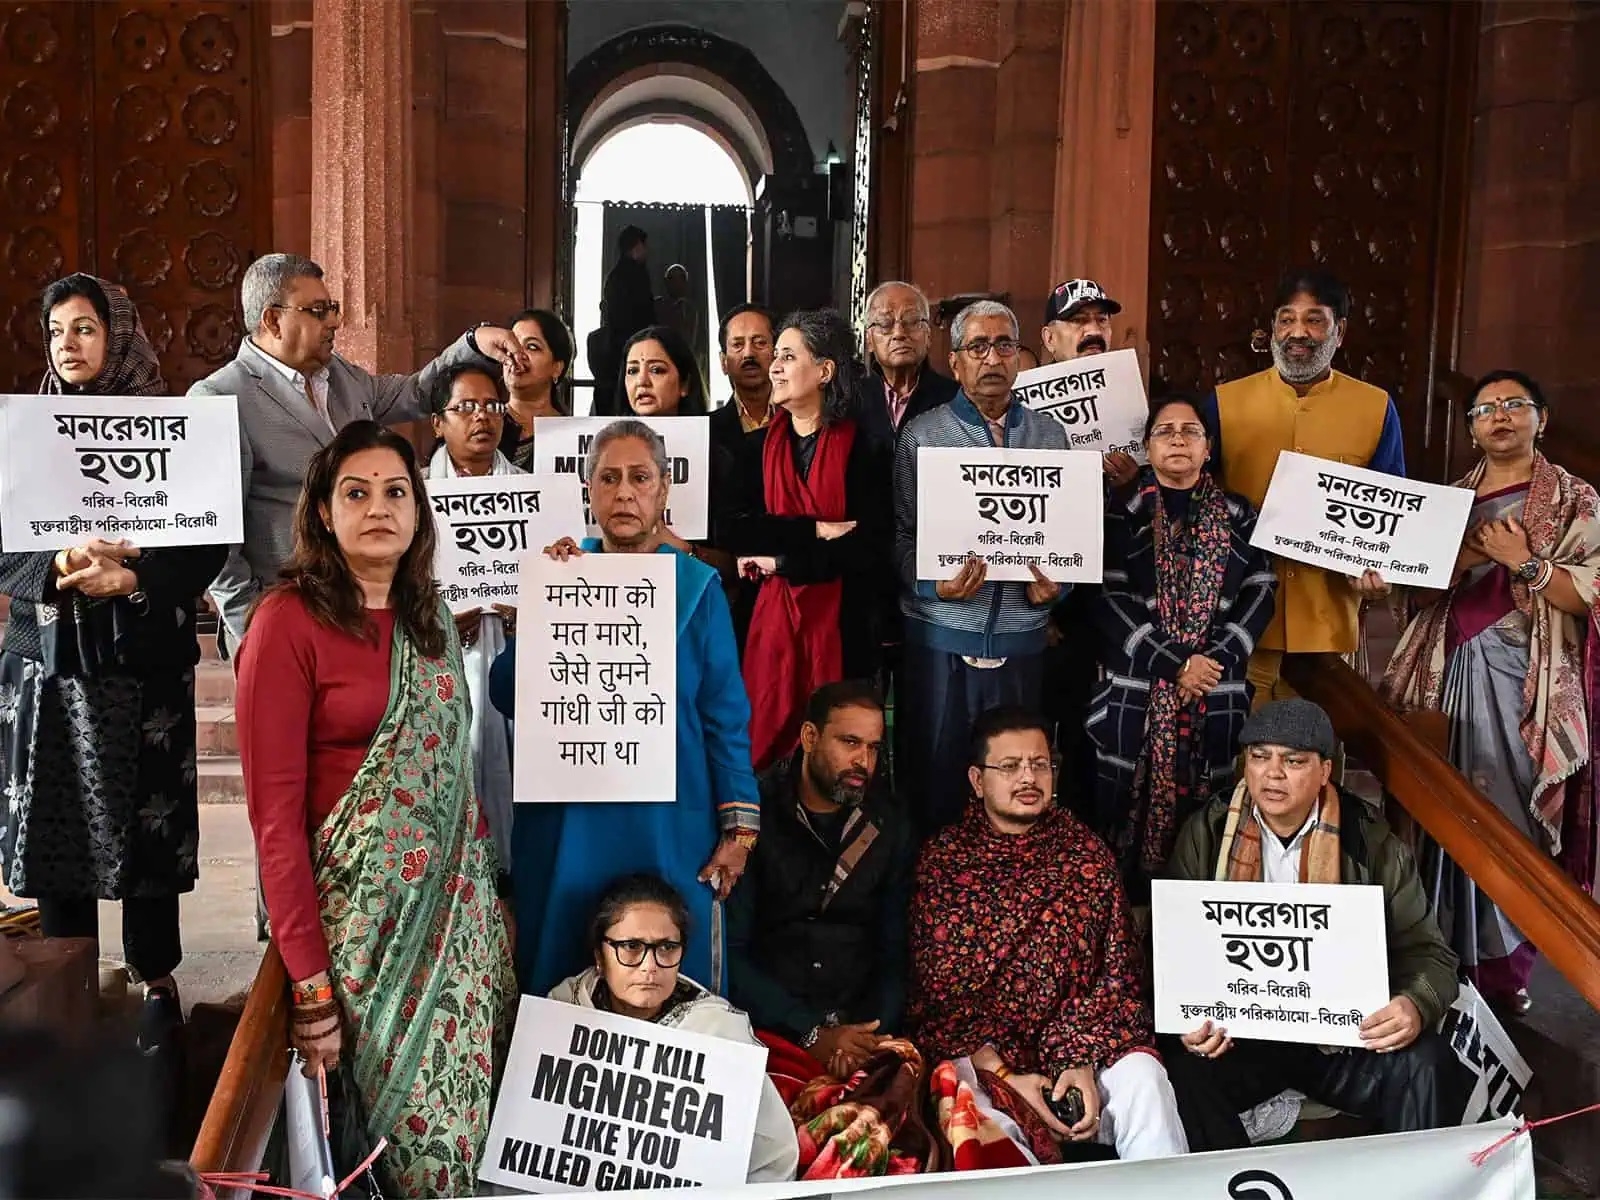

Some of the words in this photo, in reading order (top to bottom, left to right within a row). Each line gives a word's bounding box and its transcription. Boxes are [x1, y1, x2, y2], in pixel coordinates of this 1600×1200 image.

[1012, 368, 1106, 405] মনরেগার
[54, 414, 188, 441] মনরেগার
[75, 448, 171, 484] হত্যা
[960, 464, 1063, 488] মনরেগার
[82, 491, 168, 508] গরিব-বিরোধী
[431, 490, 541, 519] মনরেগার
[1317, 472, 1426, 512] মনরেগার
[30, 515, 92, 537] যুক্তরাষ্ট্রীয়
[95, 511, 217, 532] পরিকাঠামো-বিরোধী
[975, 493, 1049, 524] হত্যা
[1325, 498, 1404, 536] হত্যা
[451, 519, 528, 555] হত্যা
[978, 531, 1045, 546] গরিব-বিরোধী
[1274, 534, 1322, 554] যুক্তরাষ্ট্রীয়
[1319, 530, 1391, 554] গরিব-বিরোধী
[458, 560, 519, 576] গরিব-বিরো
[545, 577, 619, 607] मनरेगा
[624, 578, 656, 608] को
[551, 623, 588, 645] मत
[594, 615, 647, 649] मारो,
[549, 652, 591, 685] जैसे
[597, 654, 651, 692] तुमने
[541, 694, 591, 725] गांधी
[597, 694, 627, 725] जी
[633, 693, 666, 725] को
[558, 742, 606, 765] मारा
[615, 742, 640, 765] था
[1202, 901, 1331, 929] মনরেগার
[1221, 934, 1313, 971] হত্যা
[1227, 978, 1311, 998] গরিব-বিরোধী
[1180, 1001, 1236, 1021] যুক্তরাষ্ট্রীয়
[569, 1024, 649, 1070] DON'T
[652, 1044, 706, 1085] KILL
[531, 1054, 724, 1142] MGNREGA
[561, 1113, 621, 1156] LIKE
[627, 1127, 681, 1170] YOU
[498, 1137, 591, 1187] KILLED
